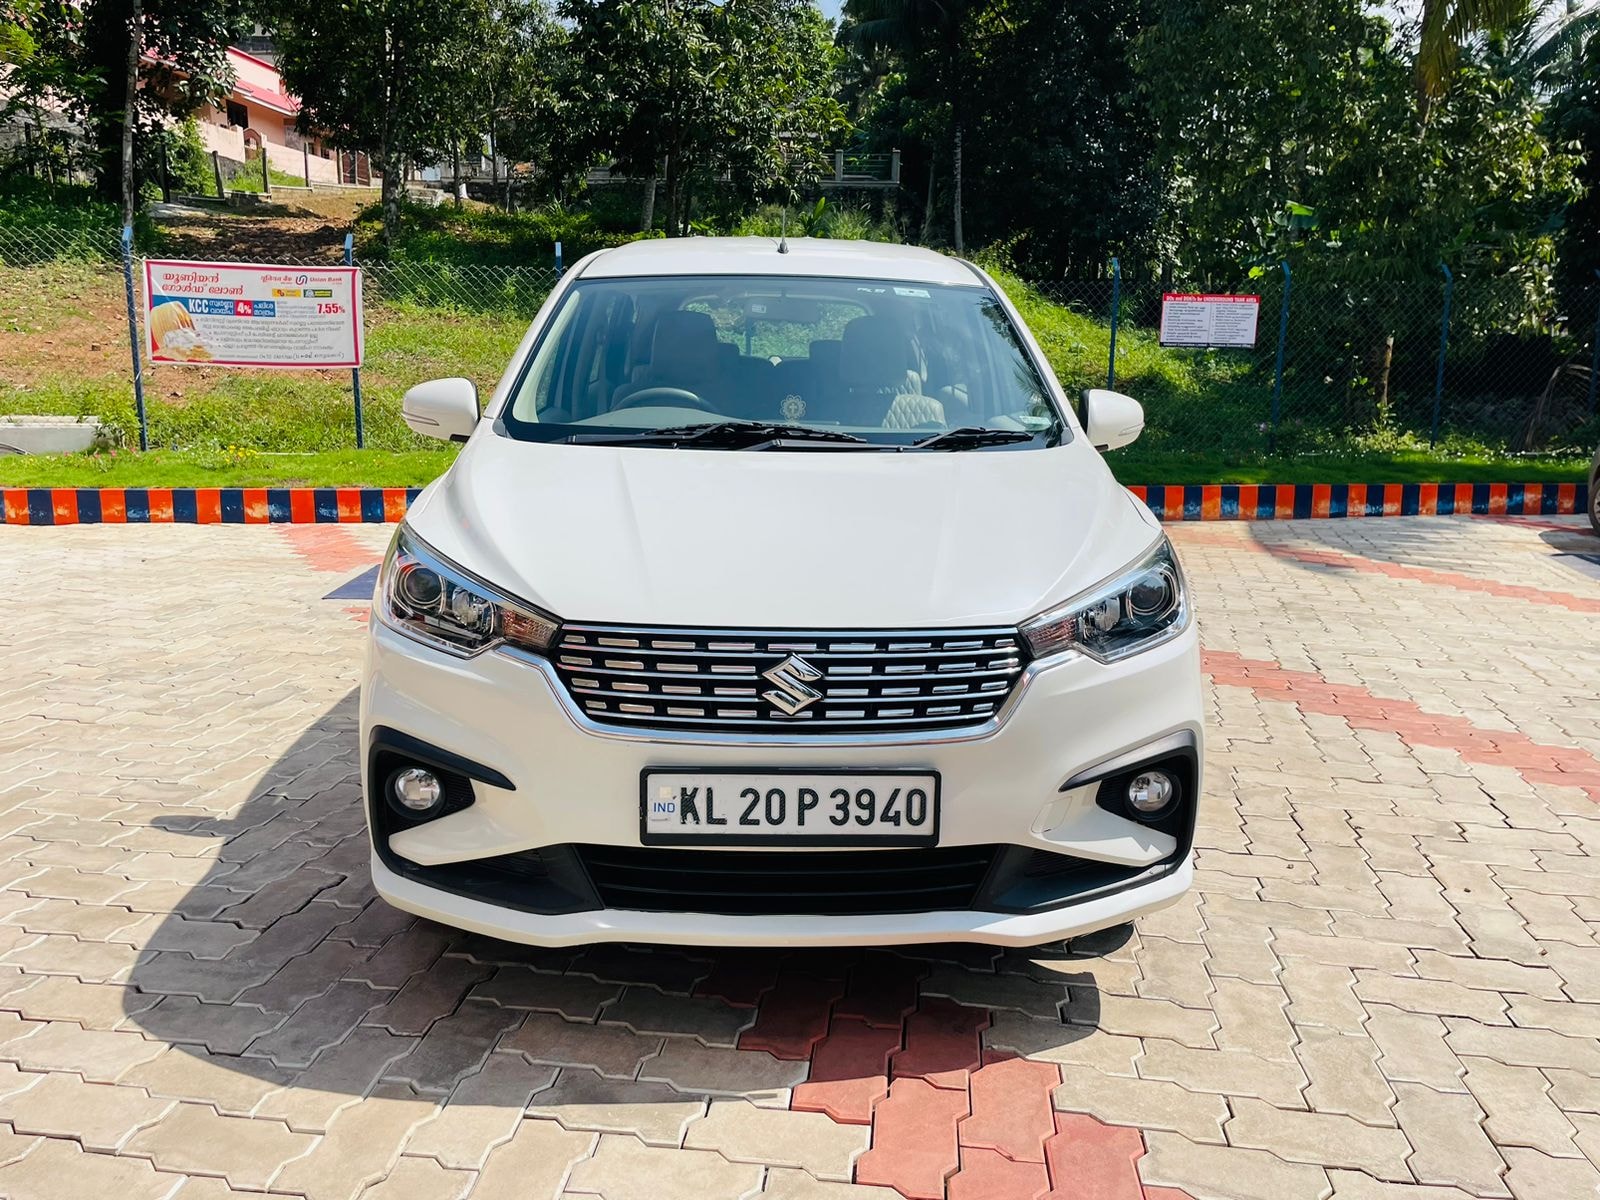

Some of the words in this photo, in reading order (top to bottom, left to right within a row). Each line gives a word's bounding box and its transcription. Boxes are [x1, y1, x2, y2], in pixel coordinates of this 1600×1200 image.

[163, 272, 219, 284] യൂണിയൻ
[188, 298, 209, 313] KCC
[237, 302, 252, 313] 4%
[317, 303, 345, 314] 7.55%
[653, 802, 675, 813] IND
[680, 787, 727, 825] KL
[739, 788, 786, 826] 20
[797, 788, 819, 826] P
[829, 788, 927, 826] 3940
